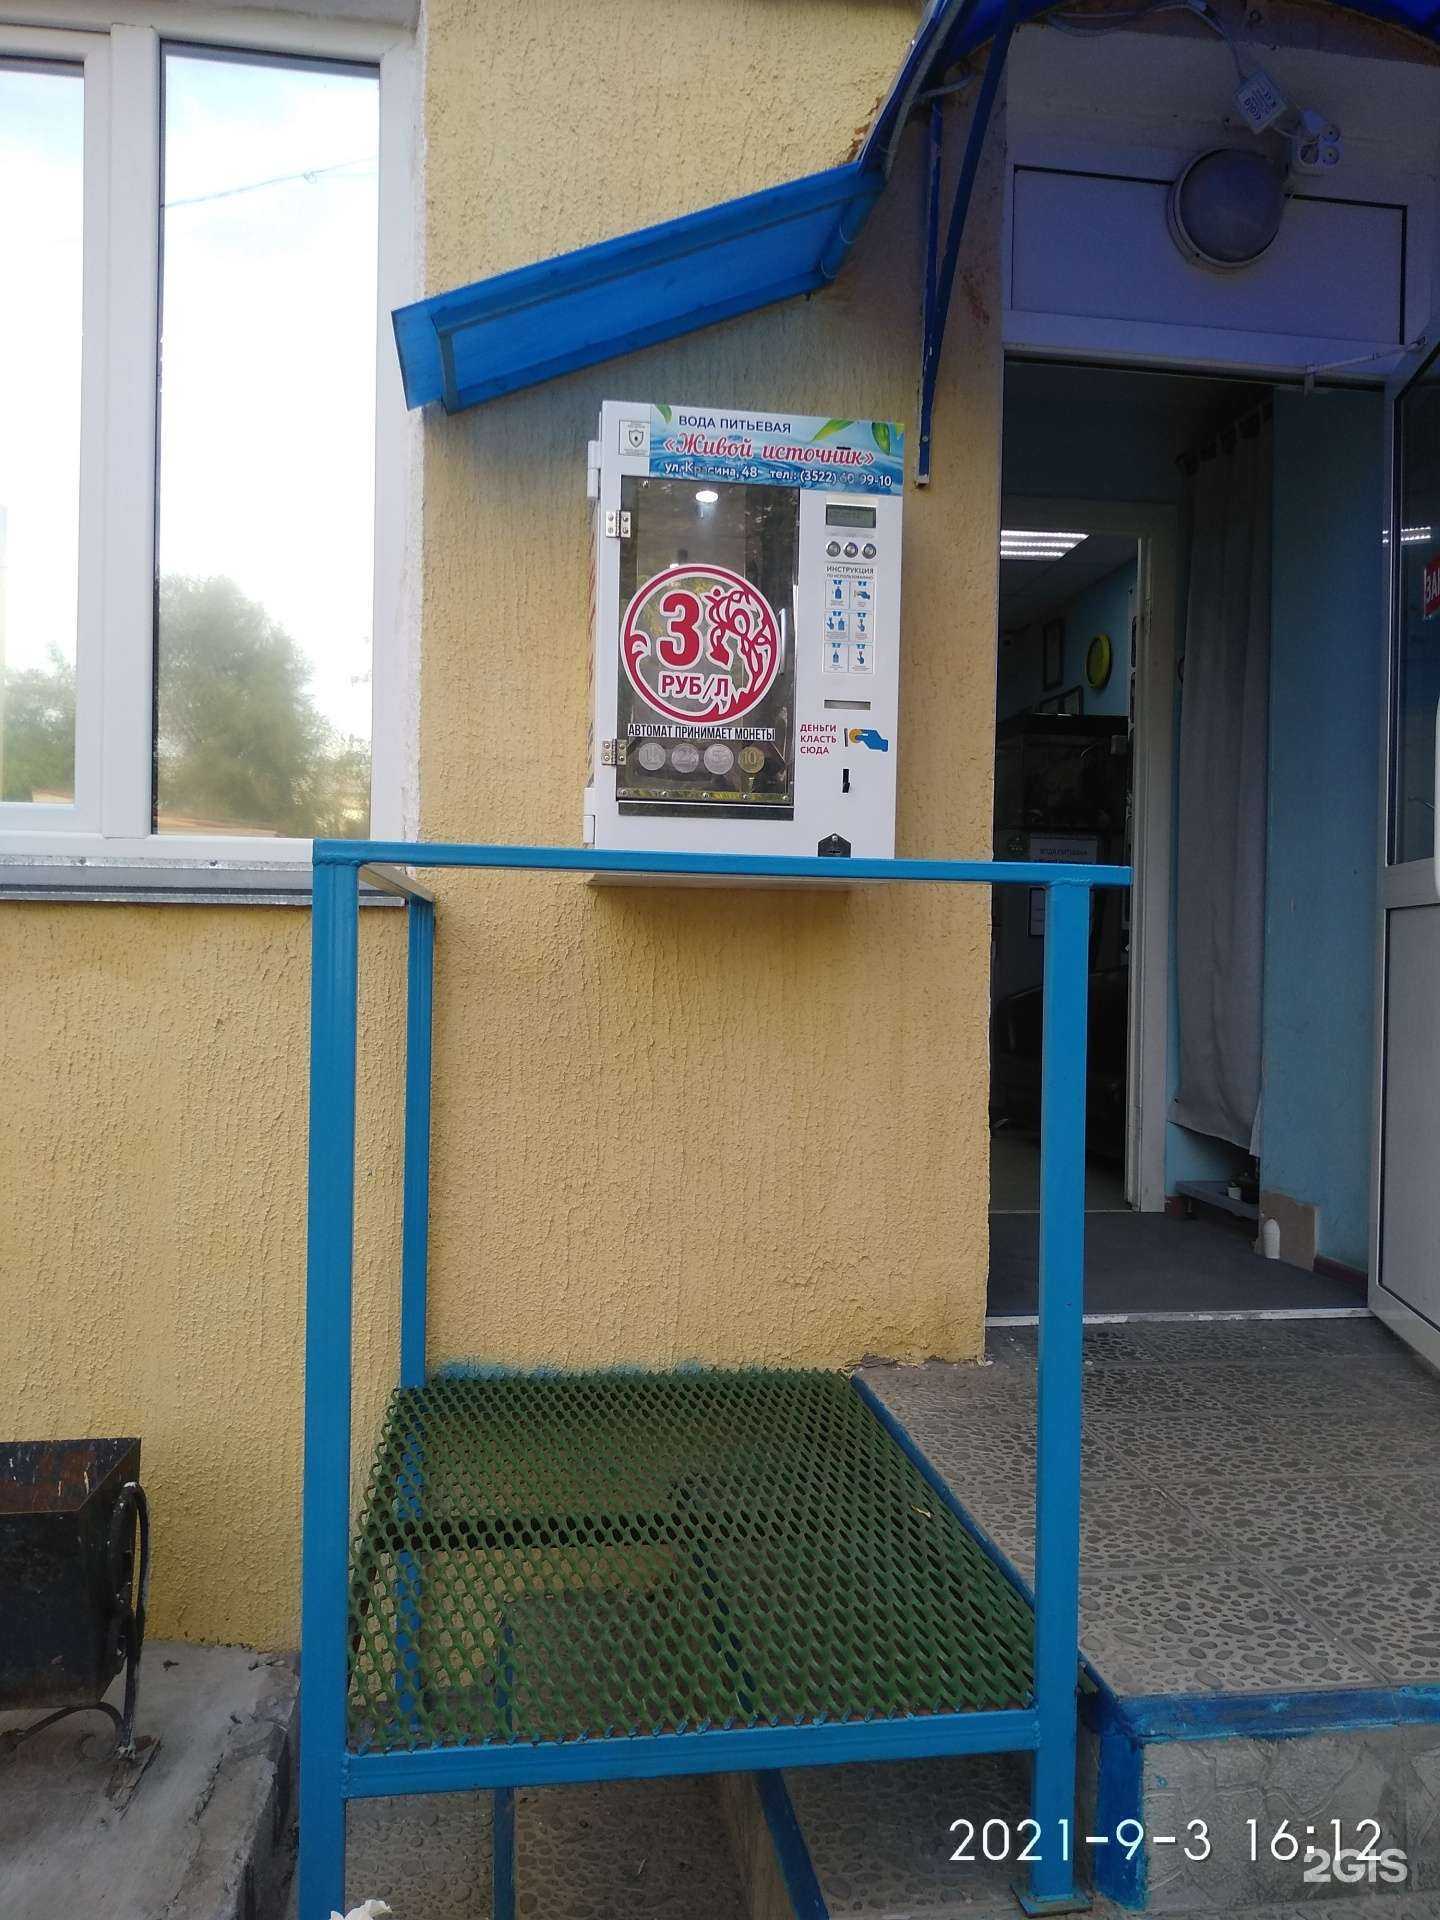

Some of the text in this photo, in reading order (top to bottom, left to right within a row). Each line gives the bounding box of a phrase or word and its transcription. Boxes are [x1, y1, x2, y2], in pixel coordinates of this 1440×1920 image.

[679, 415, 791, 434] ВОДА ПИТЬЕВАЯ
[664, 432, 875, 466] «Живой источник»
[800, 470, 837, 484] (3522)
[826, 566, 874, 575] ИНСТРУКЦИЯ
[659, 592, 701, 667] 3
[661, 674, 730, 700] РУБ/Л
[628, 724, 775, 741] АВТОМАТ ПРИНИМАЕТ МОНЕТЫ
[800, 724, 837, 733] ДЕНЬГИ
[800, 735, 837, 744] КЛАСТЬ
[800, 746, 830, 754] СЮДА
